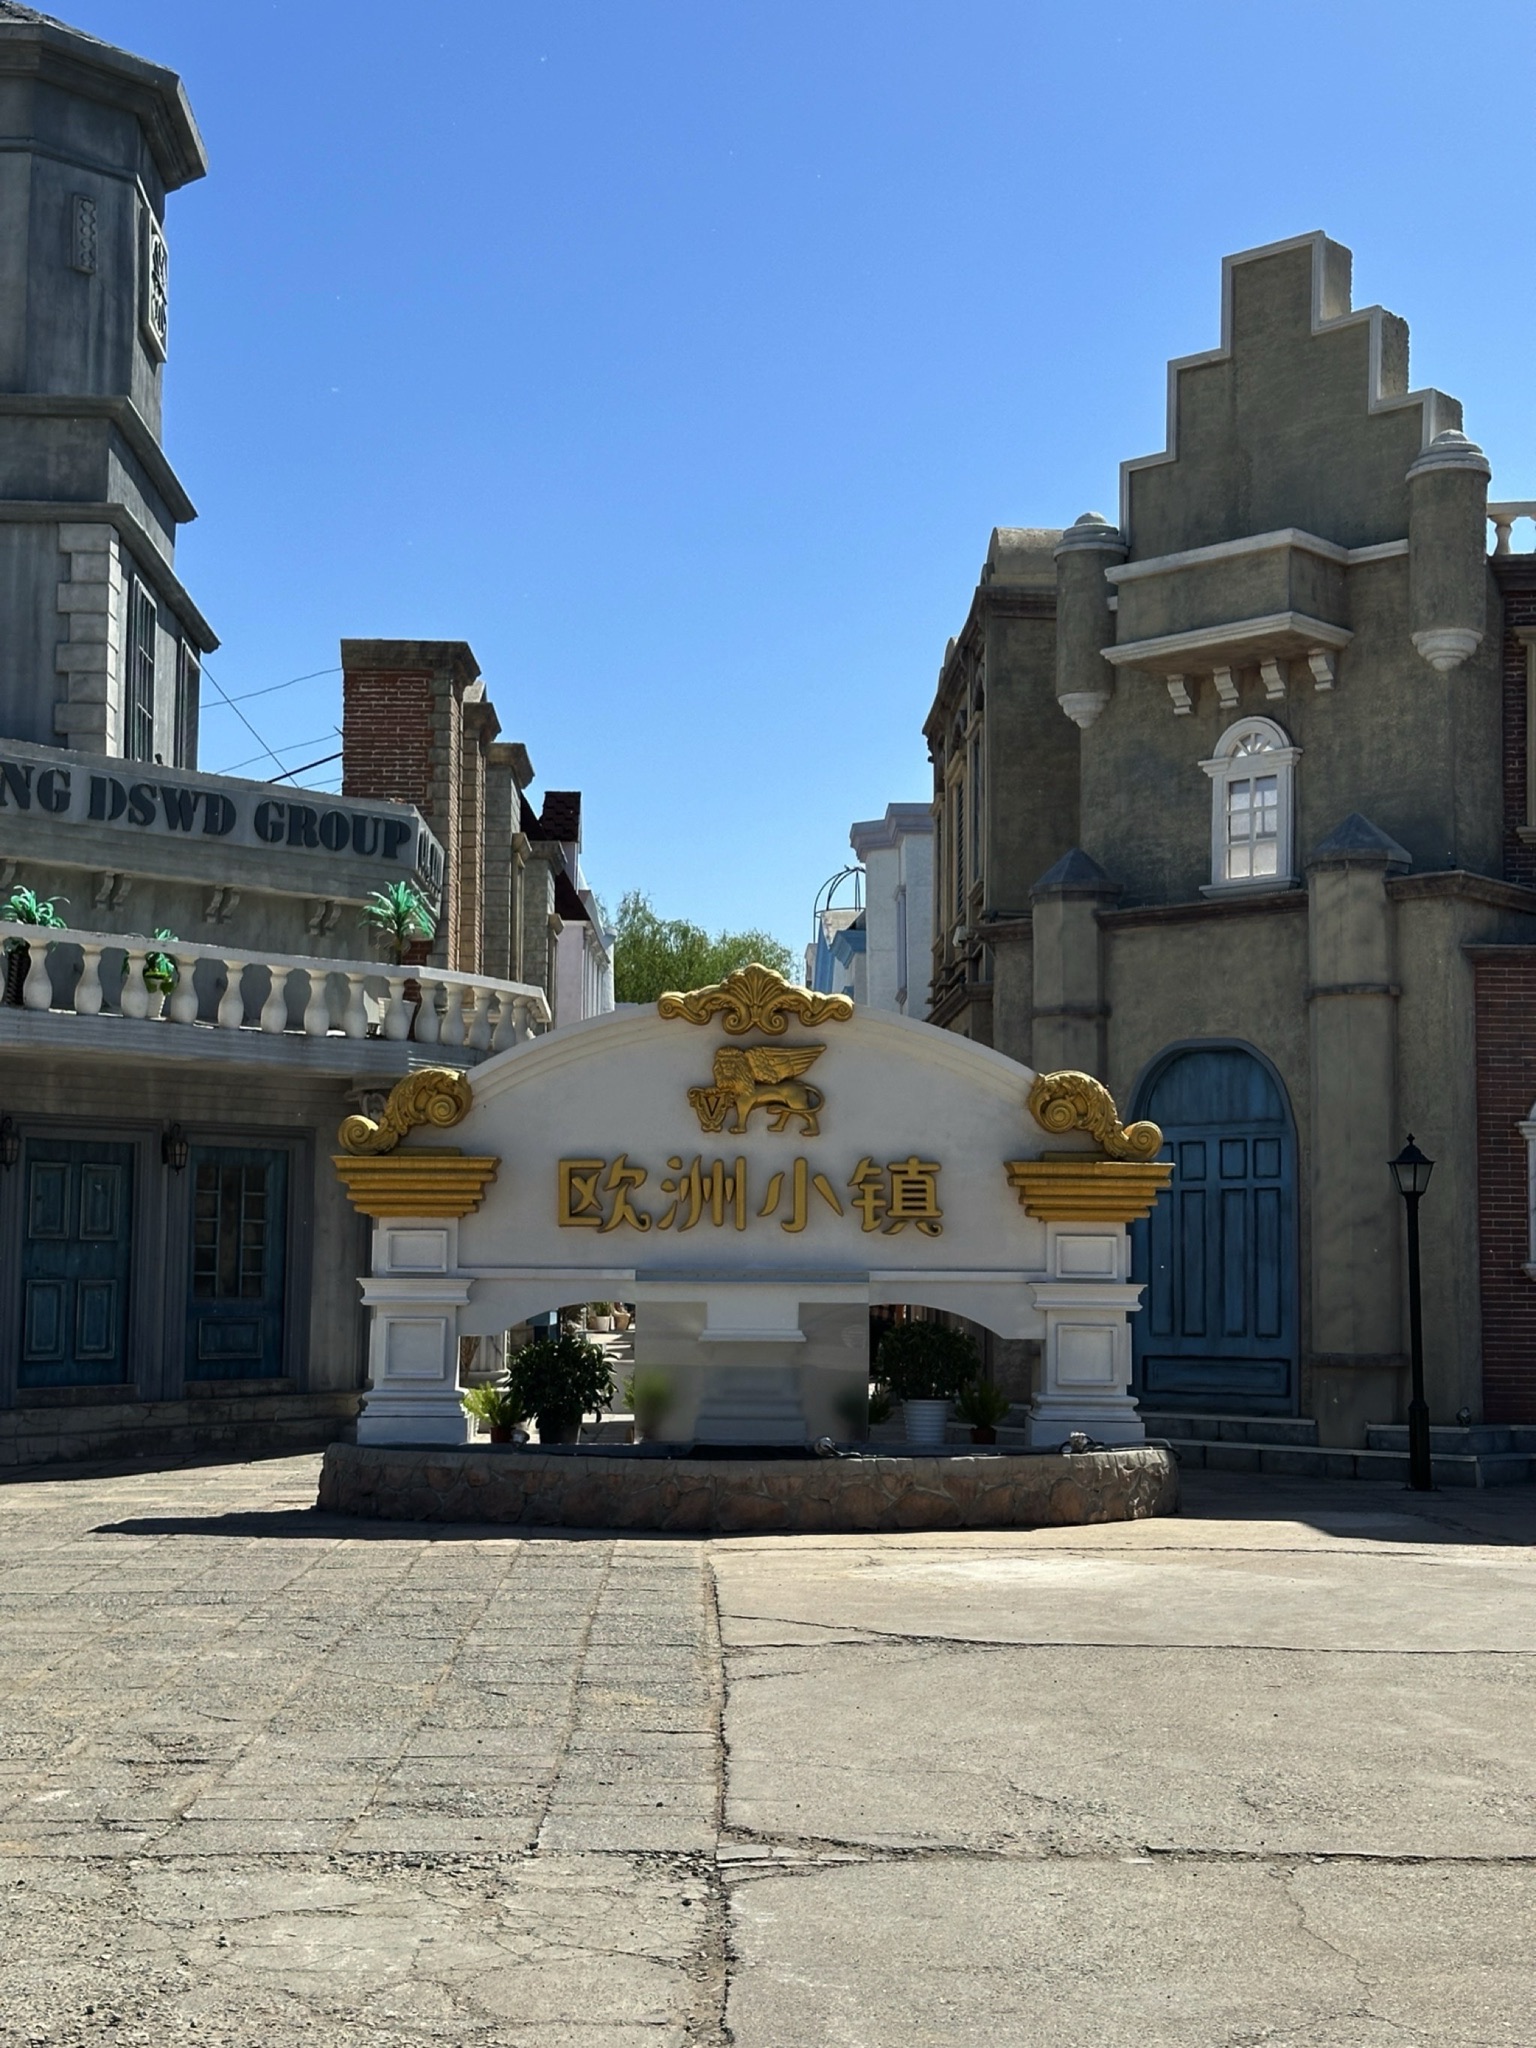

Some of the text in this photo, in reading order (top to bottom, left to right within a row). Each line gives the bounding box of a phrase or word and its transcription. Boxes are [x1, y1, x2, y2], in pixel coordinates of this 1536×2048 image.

[87, 775, 237, 836] DSWD
[254, 799, 412, 859] GROUP
[557, 1153, 944, 1237] 欧洲小镇
